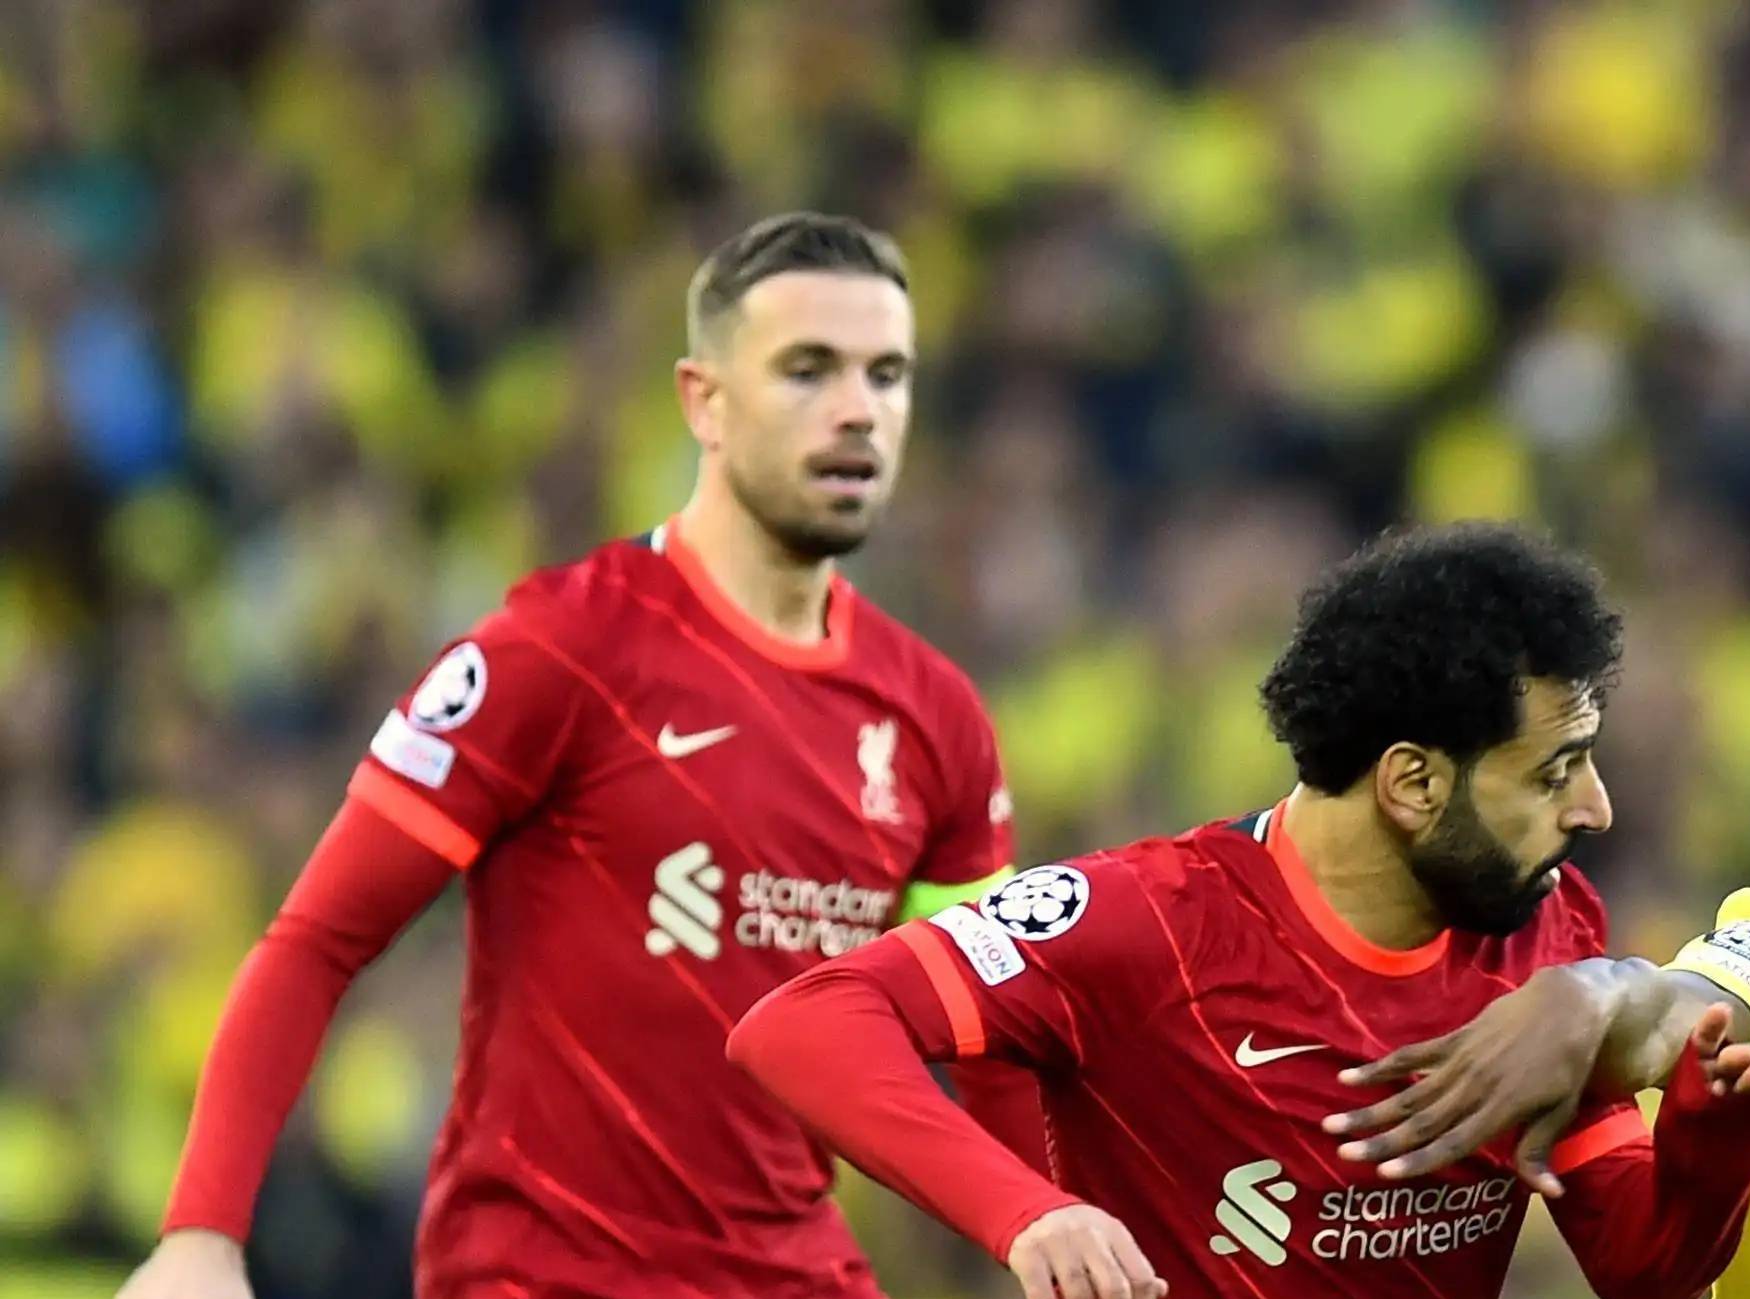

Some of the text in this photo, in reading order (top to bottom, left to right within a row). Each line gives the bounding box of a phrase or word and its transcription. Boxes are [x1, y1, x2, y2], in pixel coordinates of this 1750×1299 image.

[739, 867, 896, 926] standar
[1318, 1177, 1517, 1222] standard
[1311, 1203, 1513, 1260] chartered
